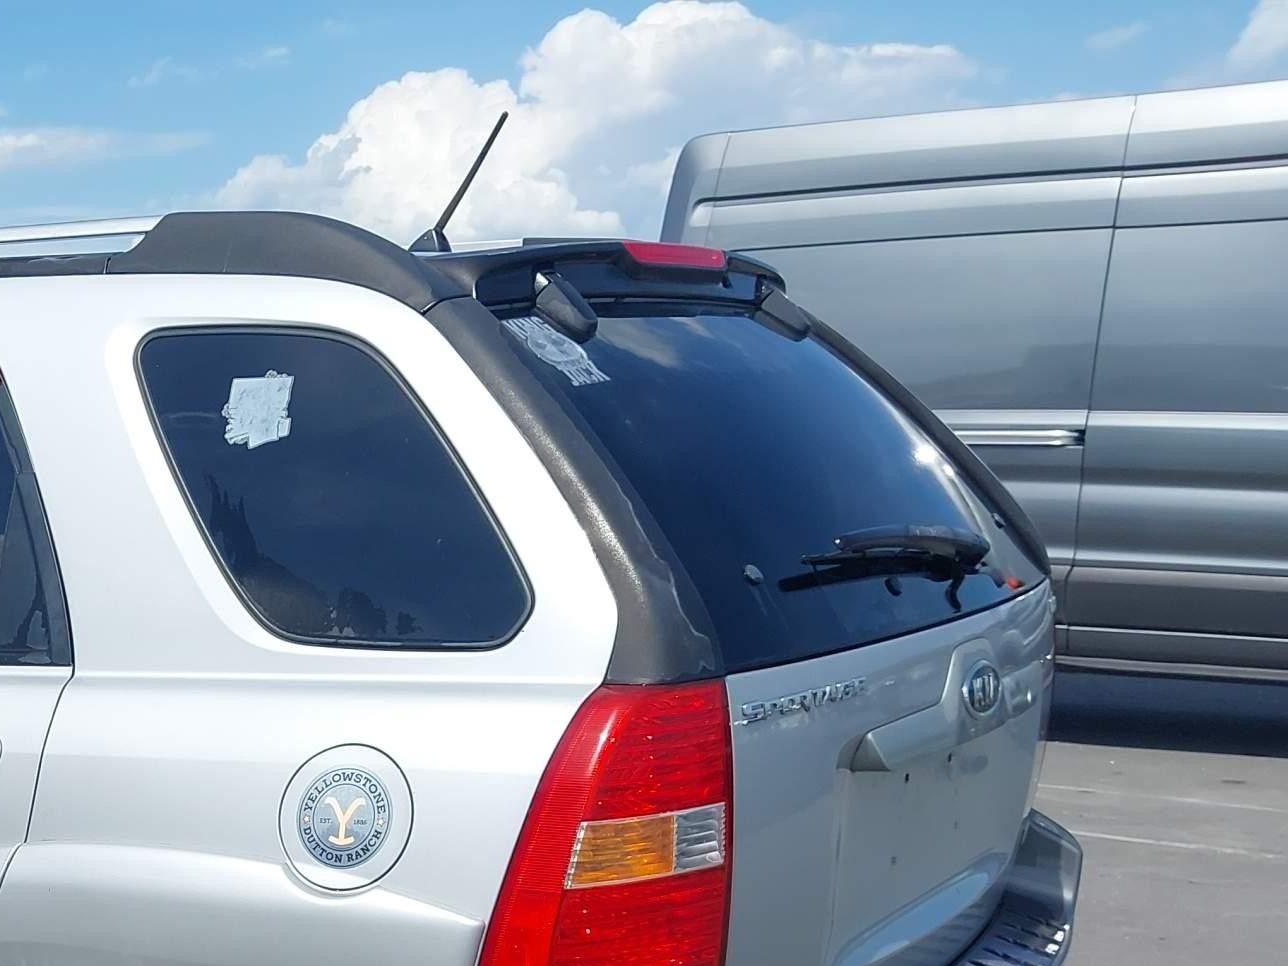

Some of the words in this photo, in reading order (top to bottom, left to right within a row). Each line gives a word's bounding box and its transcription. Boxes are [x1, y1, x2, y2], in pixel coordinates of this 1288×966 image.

[741, 677, 867, 719] SPORTAGE
[303, 772, 386, 814] YELLOWSTONE
[304, 826, 343, 863] DUTTON
[347, 830, 382, 863] RANCH
